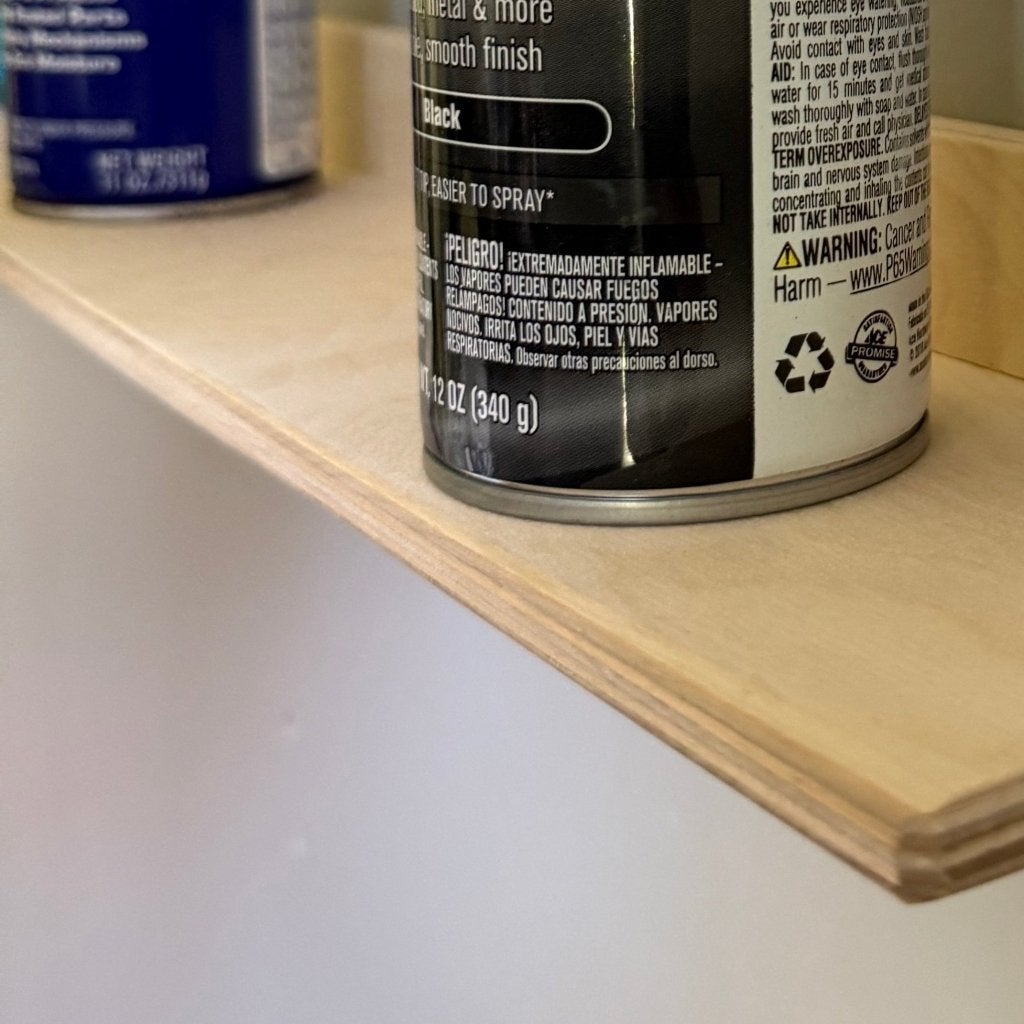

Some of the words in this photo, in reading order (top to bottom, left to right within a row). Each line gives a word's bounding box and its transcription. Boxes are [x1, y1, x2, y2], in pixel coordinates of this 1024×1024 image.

[770, 1, 790, 21] you
[803, 21, 827, 36] wear
[830, 15, 874, 37] respiratory
[426, 35, 476, 68] smooth
[483, 36, 543, 71] finish
[771, 40, 800, 60] Avoid
[808, 38, 842, 58] contact
[771, 62, 795, 82] AID:
[815, 62, 836, 78] case
[772, 86, 800, 104] water
[844, 77, 876, 97] minutes
[423, 98, 462, 130] Black
[772, 105, 799, 125] wash
[804, 100, 853, 123] thoroughly
[772, 126, 811, 149] provide
[816, 122, 839, 143] fresh
[773, 147, 805, 168] TERM
[808, 137, 883, 166] OVEREXPOSURE.
[432, 175, 467, 204] EASIER
[471, 183, 488, 208] TO
[773, 170, 799, 191] brain
[826, 165, 860, 184] nervous
[773, 188, 840, 212] concentrating
[773, 213, 796, 233] NOT
[801, 209, 826, 230] TAKE
[830, 199, 885, 227] INTERNALLY.
[802, 226, 882, 266] WARNING:
[885, 219, 915, 250] Cancer
[629, 254, 712, 277] INFLAMABLE
[446, 263, 460, 286] LOS
[460, 267, 502, 293] VAPORES
[504, 274, 549, 298] PUEDEN
[552, 277, 602, 300] CAUSAR
[606, 278, 659, 300] FUEGOS
[774, 275, 821, 302] Harm
[508, 297, 574, 323] CONTENIDO
[578, 302, 586, 323] A
[656, 299, 718, 323] VAPORES
[446, 307, 482, 336] NOCIVOS.
[484, 317, 517, 341] IRRITA
[520, 321, 541, 343] LOS
[544, 323, 580, 349] OJOS,
[584, 326, 612, 347] PIEL
[616, 325, 624, 347] Y
[865, 329, 887, 344] ACE
[446, 330, 514, 365] RESPIRATORIAS.
[516, 346, 558, 368] Observar
[561, 351, 589, 370] otras
[591, 352, 666, 374] precauciones
[669, 350, 680, 369] al
[683, 350, 718, 369] dorso.
[851, 346, 895, 359] PROMISE
[432, 376, 445, 406] 12
[448, 379, 466, 414] OZ
[471, 384, 510, 424] (340
[517, 394, 539, 435] g)
